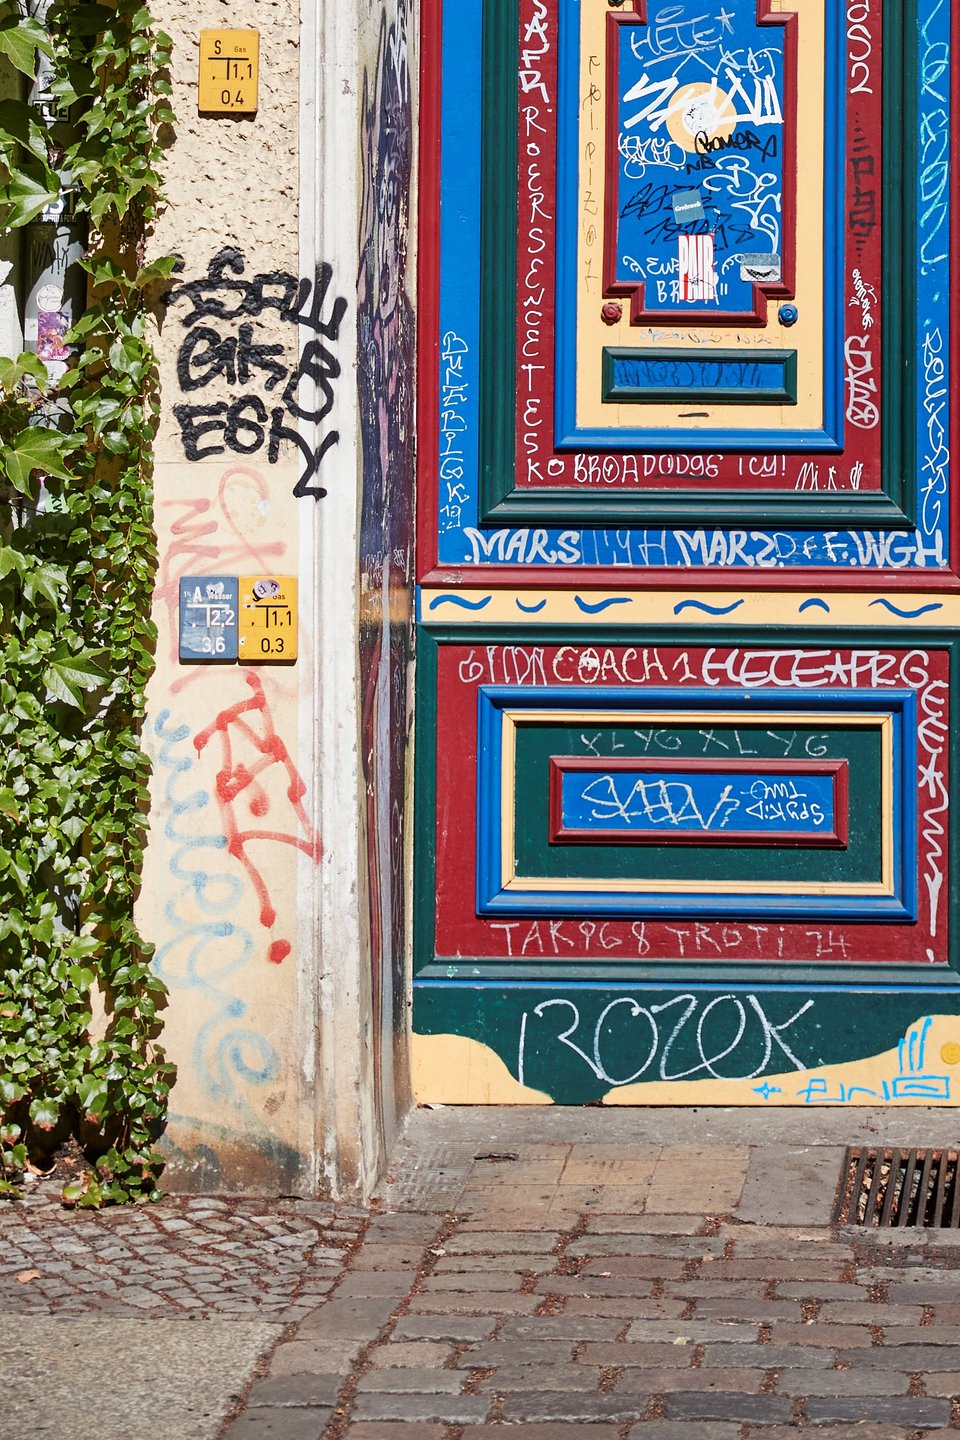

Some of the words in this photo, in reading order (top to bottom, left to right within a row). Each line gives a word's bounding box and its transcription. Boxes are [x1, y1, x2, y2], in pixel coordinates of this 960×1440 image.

[214, 40, 222, 55] S
[233, 45, 247, 53] Gas
[232, 63, 253, 81] 1,1
[221, 89, 245, 107] 0,4
[210, 609, 235, 628] 2,2
[271, 610, 292, 627] 1,1
[201, 636, 226, 656] 3,6
[260, 637, 285, 654] 0,3
